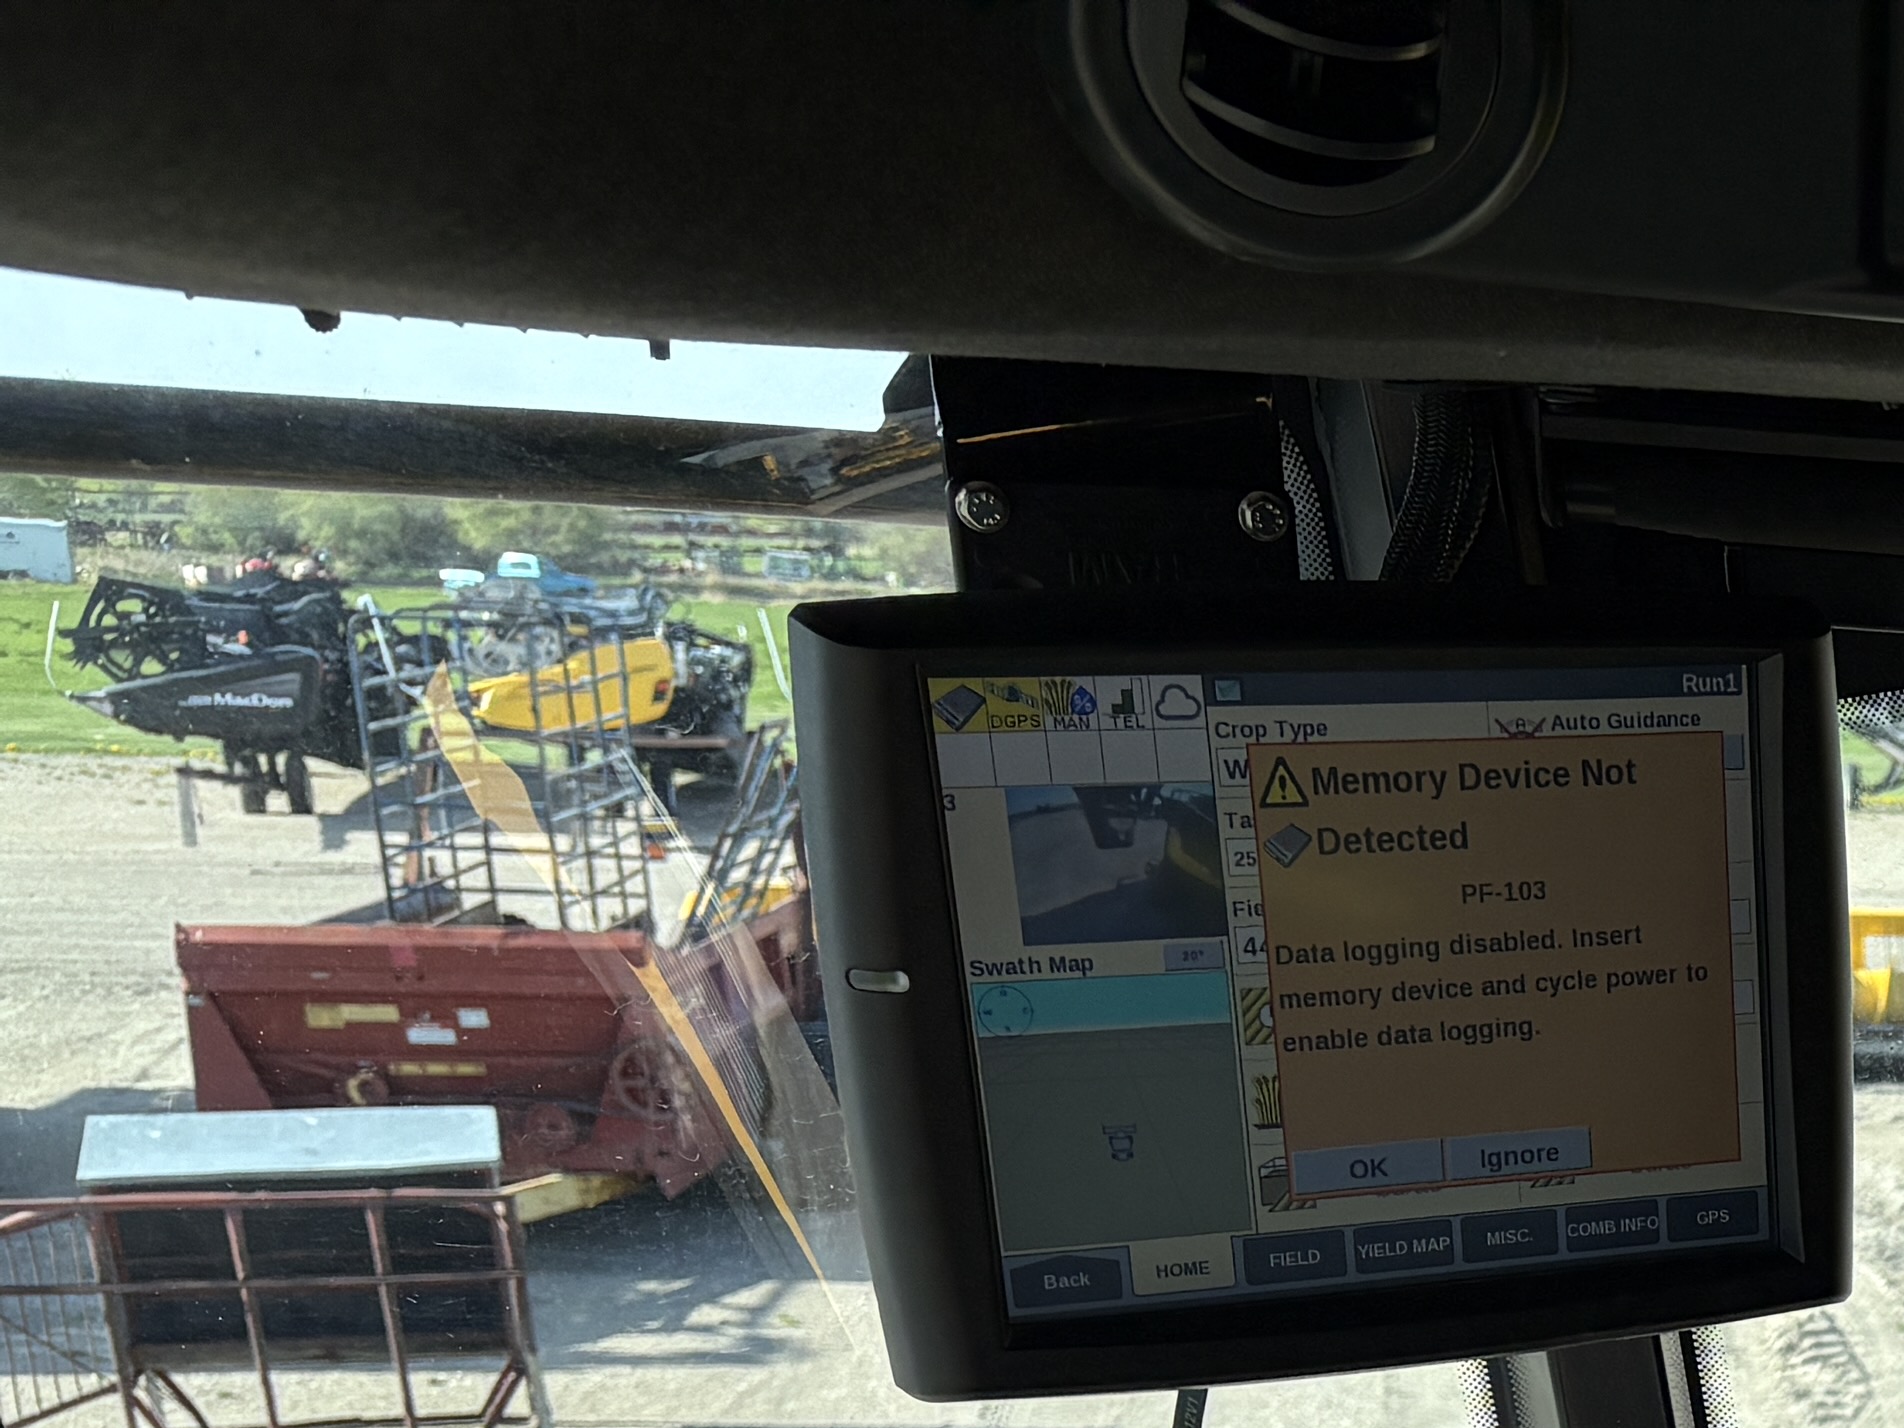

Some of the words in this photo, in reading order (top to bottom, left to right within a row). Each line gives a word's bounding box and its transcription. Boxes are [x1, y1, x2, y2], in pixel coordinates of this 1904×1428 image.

[1682, 673, 1739, 693] Run1
[990, 713, 1041, 729] DGPS
[1053, 715, 1091, 730] MAN
[1111, 714, 1146, 730] TEL
[1215, 721, 1267, 741] Crop
[1274, 720, 1328, 743] Type
[1551, 713, 1600, 732] Auto
[1607, 711, 1701, 730] Guidance
[1311, 766, 1447, 800] Memory
[1458, 760, 1570, 791] Device
[1582, 758, 1637, 787] Not
[1317, 821, 1469, 855] Detected
[1461, 881, 1546, 904] PF-103
[1276, 944, 1336, 965] Data
[1343, 938, 1440, 966] logging
[1450, 929, 1562, 955] disabled.
[1573, 925, 1642, 948] Insert
[969, 955, 1042, 977] Swath
[1050, 955, 1093, 978] Map
[1280, 986, 1382, 1010] memory
[1392, 979, 1472, 1002] device
[1482, 974, 1526, 997] and
[1535, 969, 1597, 997] cycle
[1606, 967, 1677, 993] power
[1686, 963, 1708, 983] to
[1283, 1028, 1368, 1052] enable
[1377, 1025, 1433, 1046] data
[1441, 1017, 1541, 1046] logging.
[1350, 1157, 1389, 1179] OK
[1480, 1146, 1559, 1173] Ignore
[1567, 1218, 1616, 1238] COMB
[1621, 1215, 1659, 1231] INFO
[1696, 1209, 1730, 1225] GPS
[1357, 1241, 1407, 1259] YIELD
[1412, 1236, 1450, 1253] MAP
[1487, 1228, 1533, 1246] MISC.
[1269, 1249, 1321, 1267] FIELD
[1156, 1260, 1210, 1279] HOME
[1044, 1272, 1091, 1290] Back
